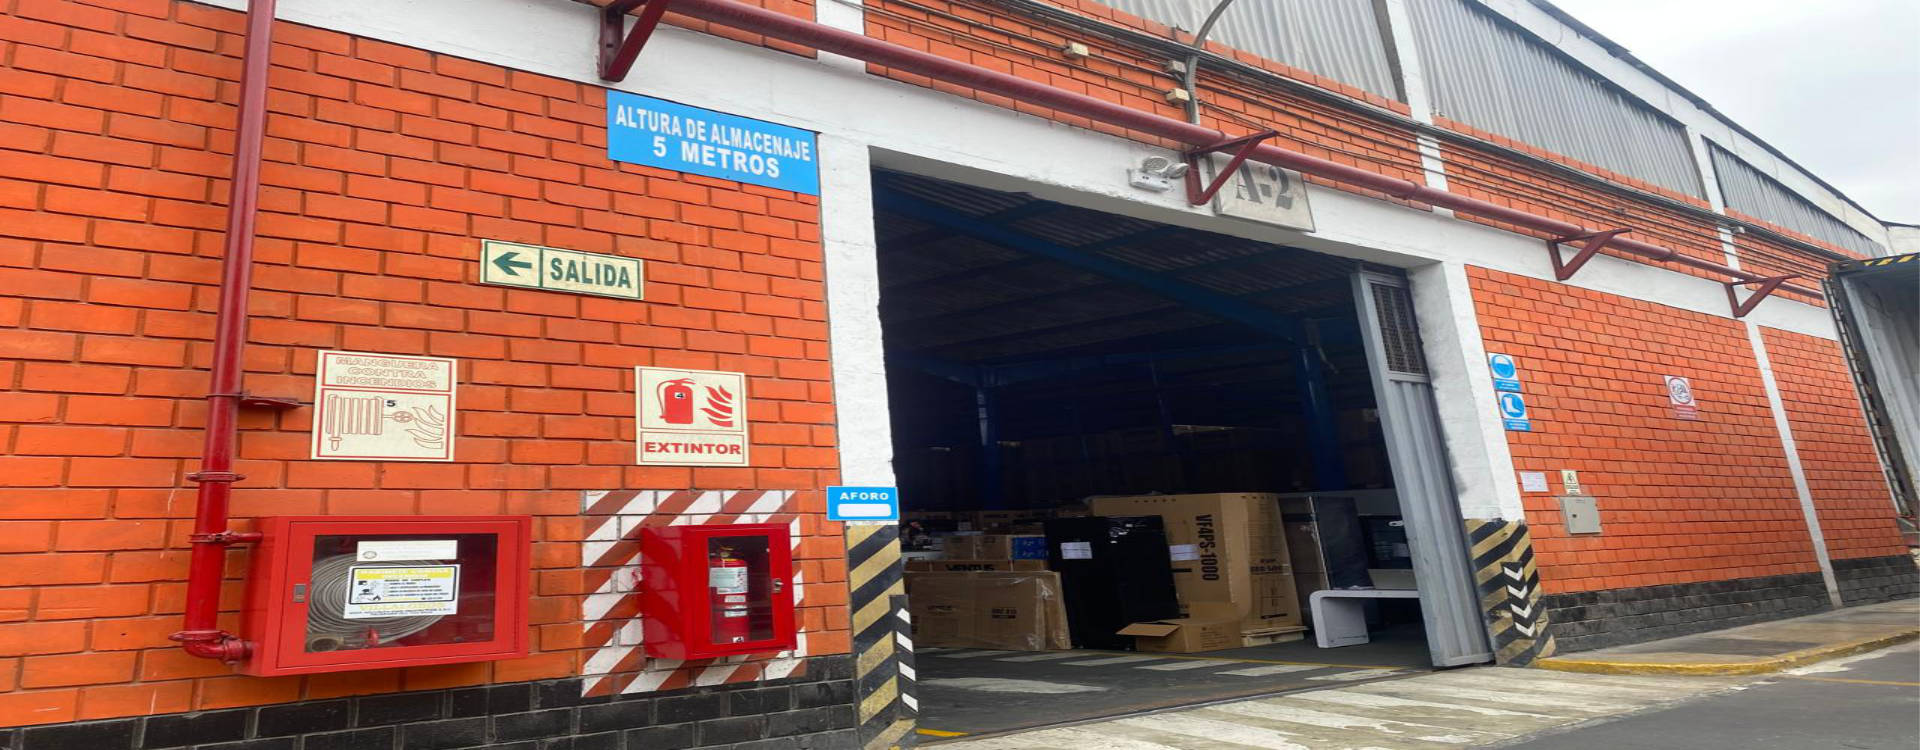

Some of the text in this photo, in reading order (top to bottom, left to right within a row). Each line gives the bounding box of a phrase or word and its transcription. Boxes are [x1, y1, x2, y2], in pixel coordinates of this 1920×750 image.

[616, 104, 811, 161] ALTURA DE ALMACENAJE
[653, 136, 780, 178] 5 METROS
[550, 257, 632, 289] SALIDA
[336, 357, 438, 370] MANGUERA
[347, 367, 426, 379] CONTRA
[336, 376, 437, 388] INCENDIOS
[645, 442, 741, 454] EXTINTOR
[840, 492, 888, 500] AFORO
[1195, 514, 1219, 581] VF4PS-1000
